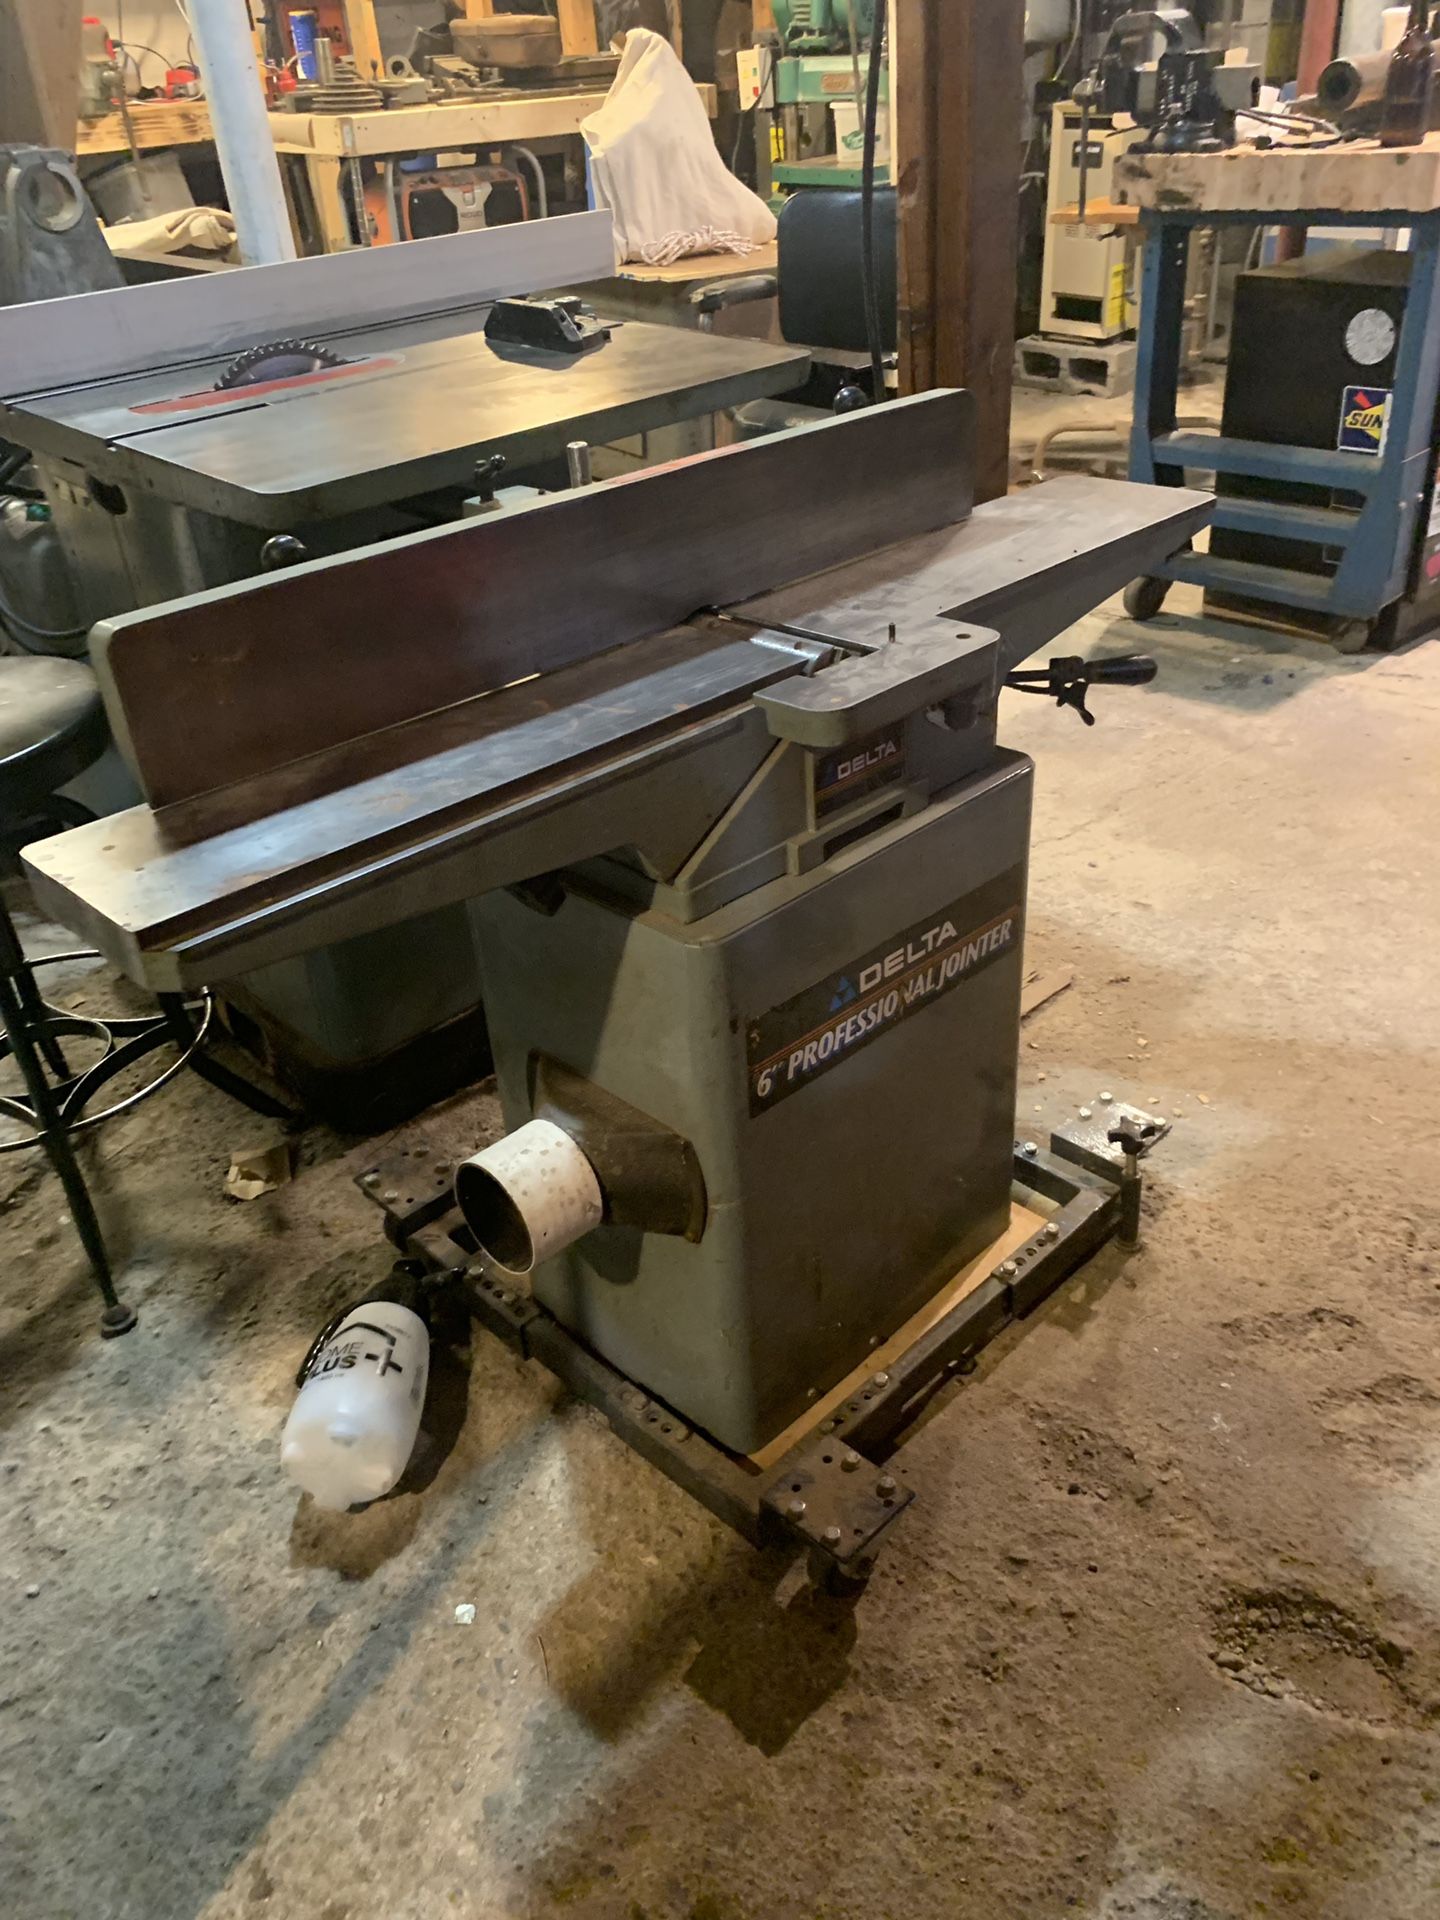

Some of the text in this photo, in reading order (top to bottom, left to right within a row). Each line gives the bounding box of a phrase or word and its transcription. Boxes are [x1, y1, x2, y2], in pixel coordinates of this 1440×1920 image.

[837, 740, 897, 780] DELTA
[859, 920, 957, 994] DELTA
[935, 918, 1013, 991] JOINTER
[309, 1354, 358, 1379] LUS
